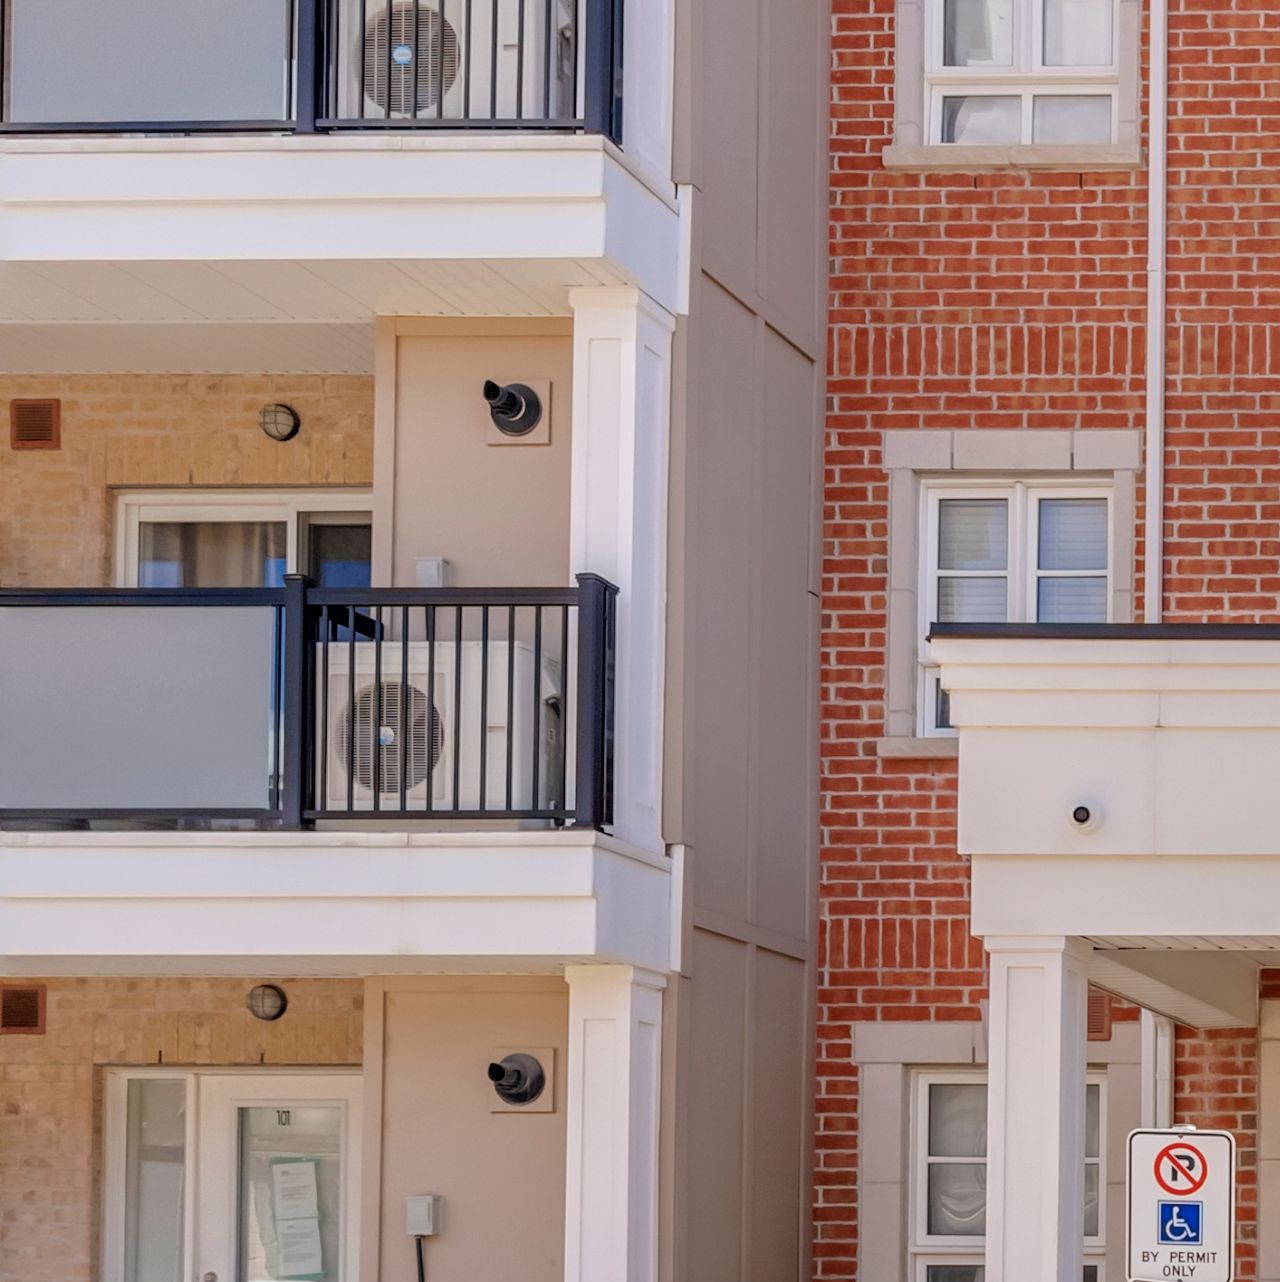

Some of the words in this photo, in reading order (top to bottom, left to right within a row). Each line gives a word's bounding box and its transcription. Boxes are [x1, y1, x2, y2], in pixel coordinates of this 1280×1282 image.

[276, 1110, 291, 1126] 101
[1142, 1251, 1159, 1262] BY
[1170, 1252, 1217, 1263] PERMIT
[1163, 1265, 1196, 1277] ONLY
